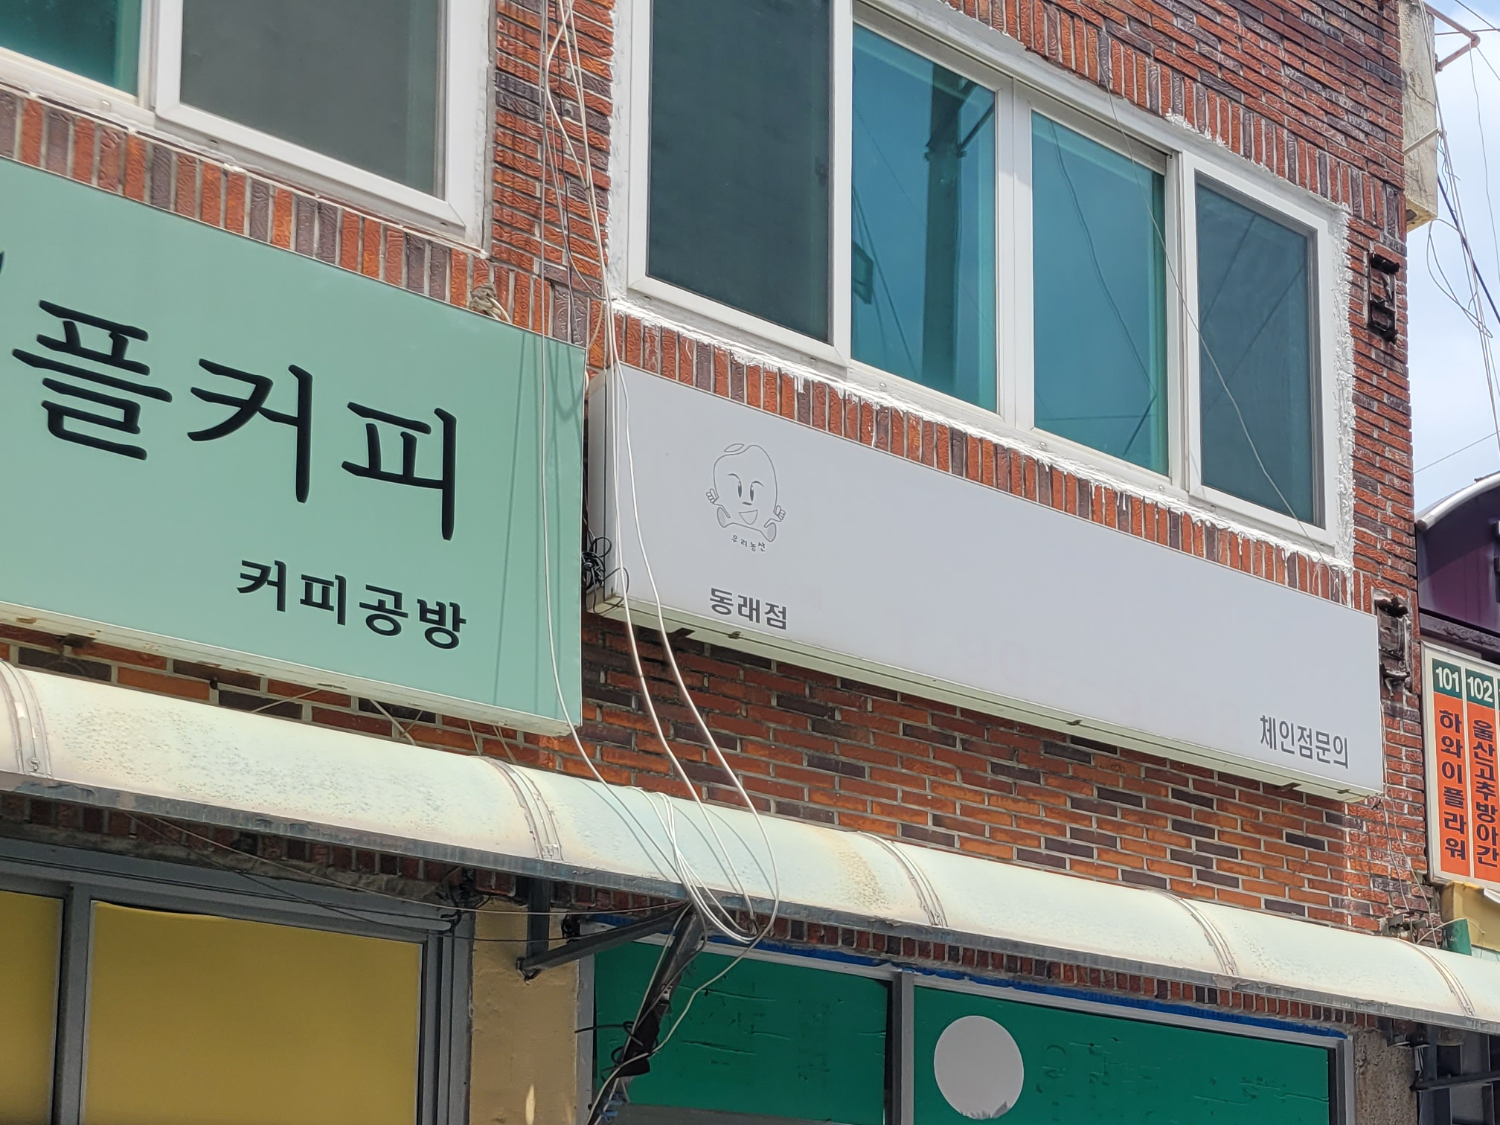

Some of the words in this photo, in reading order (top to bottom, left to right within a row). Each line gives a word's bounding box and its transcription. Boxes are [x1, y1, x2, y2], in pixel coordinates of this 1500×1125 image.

[0, 251, 458, 542] 플커피
[731, 534, 767, 553] 우리농산
[236, 558, 467, 651] 커피공방
[709, 587, 788, 631] 동래점
[1436, 667, 1460, 693] 101
[1467, 676, 1493, 702] 102
[1258, 713, 1350, 770] 체인점문의
[1438, 709, 1467, 861] 하와이플라워
[1471, 719, 1500, 868] 울산고추방아간
